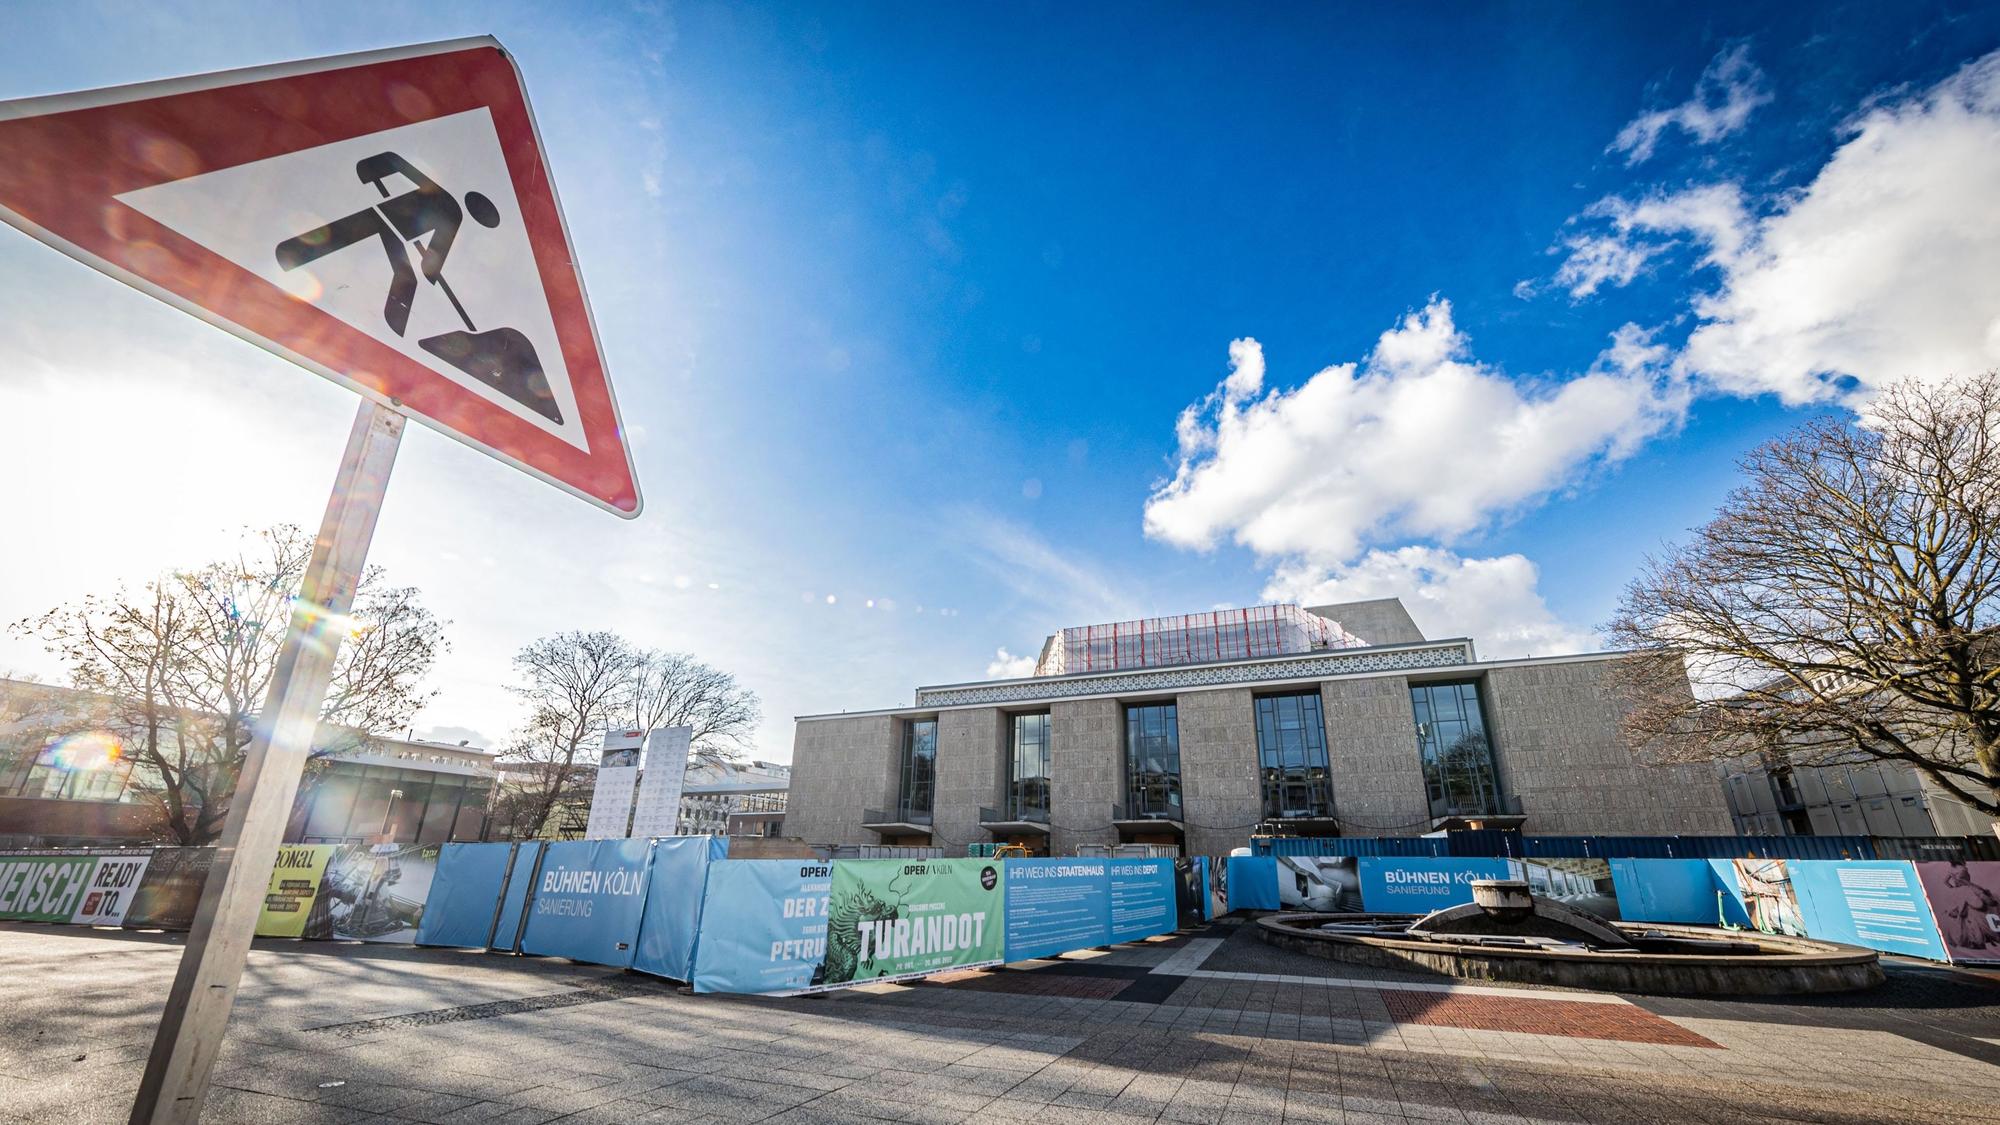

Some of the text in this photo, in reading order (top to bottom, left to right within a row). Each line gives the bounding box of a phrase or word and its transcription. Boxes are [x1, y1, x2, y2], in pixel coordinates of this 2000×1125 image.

[94, 862, 143, 888] READY
[1010, 867, 1024, 880] IHR
[1025, 866, 1043, 879] WEG
[1044, 866, 1057, 877] INS
[1057, 865, 1104, 877] STAATENHAUS
[1111, 864, 1158, 876] IHR WEG INS DEPOT
[1384, 869, 1450, 884] BÜHNEN
[543, 866, 644, 895] BÜHNEN KÖLN
[1386, 886, 1450, 895] SANIERUNG
[538, 898, 593, 917] SANIERUNG
[783, 897, 816, 918] DER
[857, 911, 986, 961] TURANDOT
